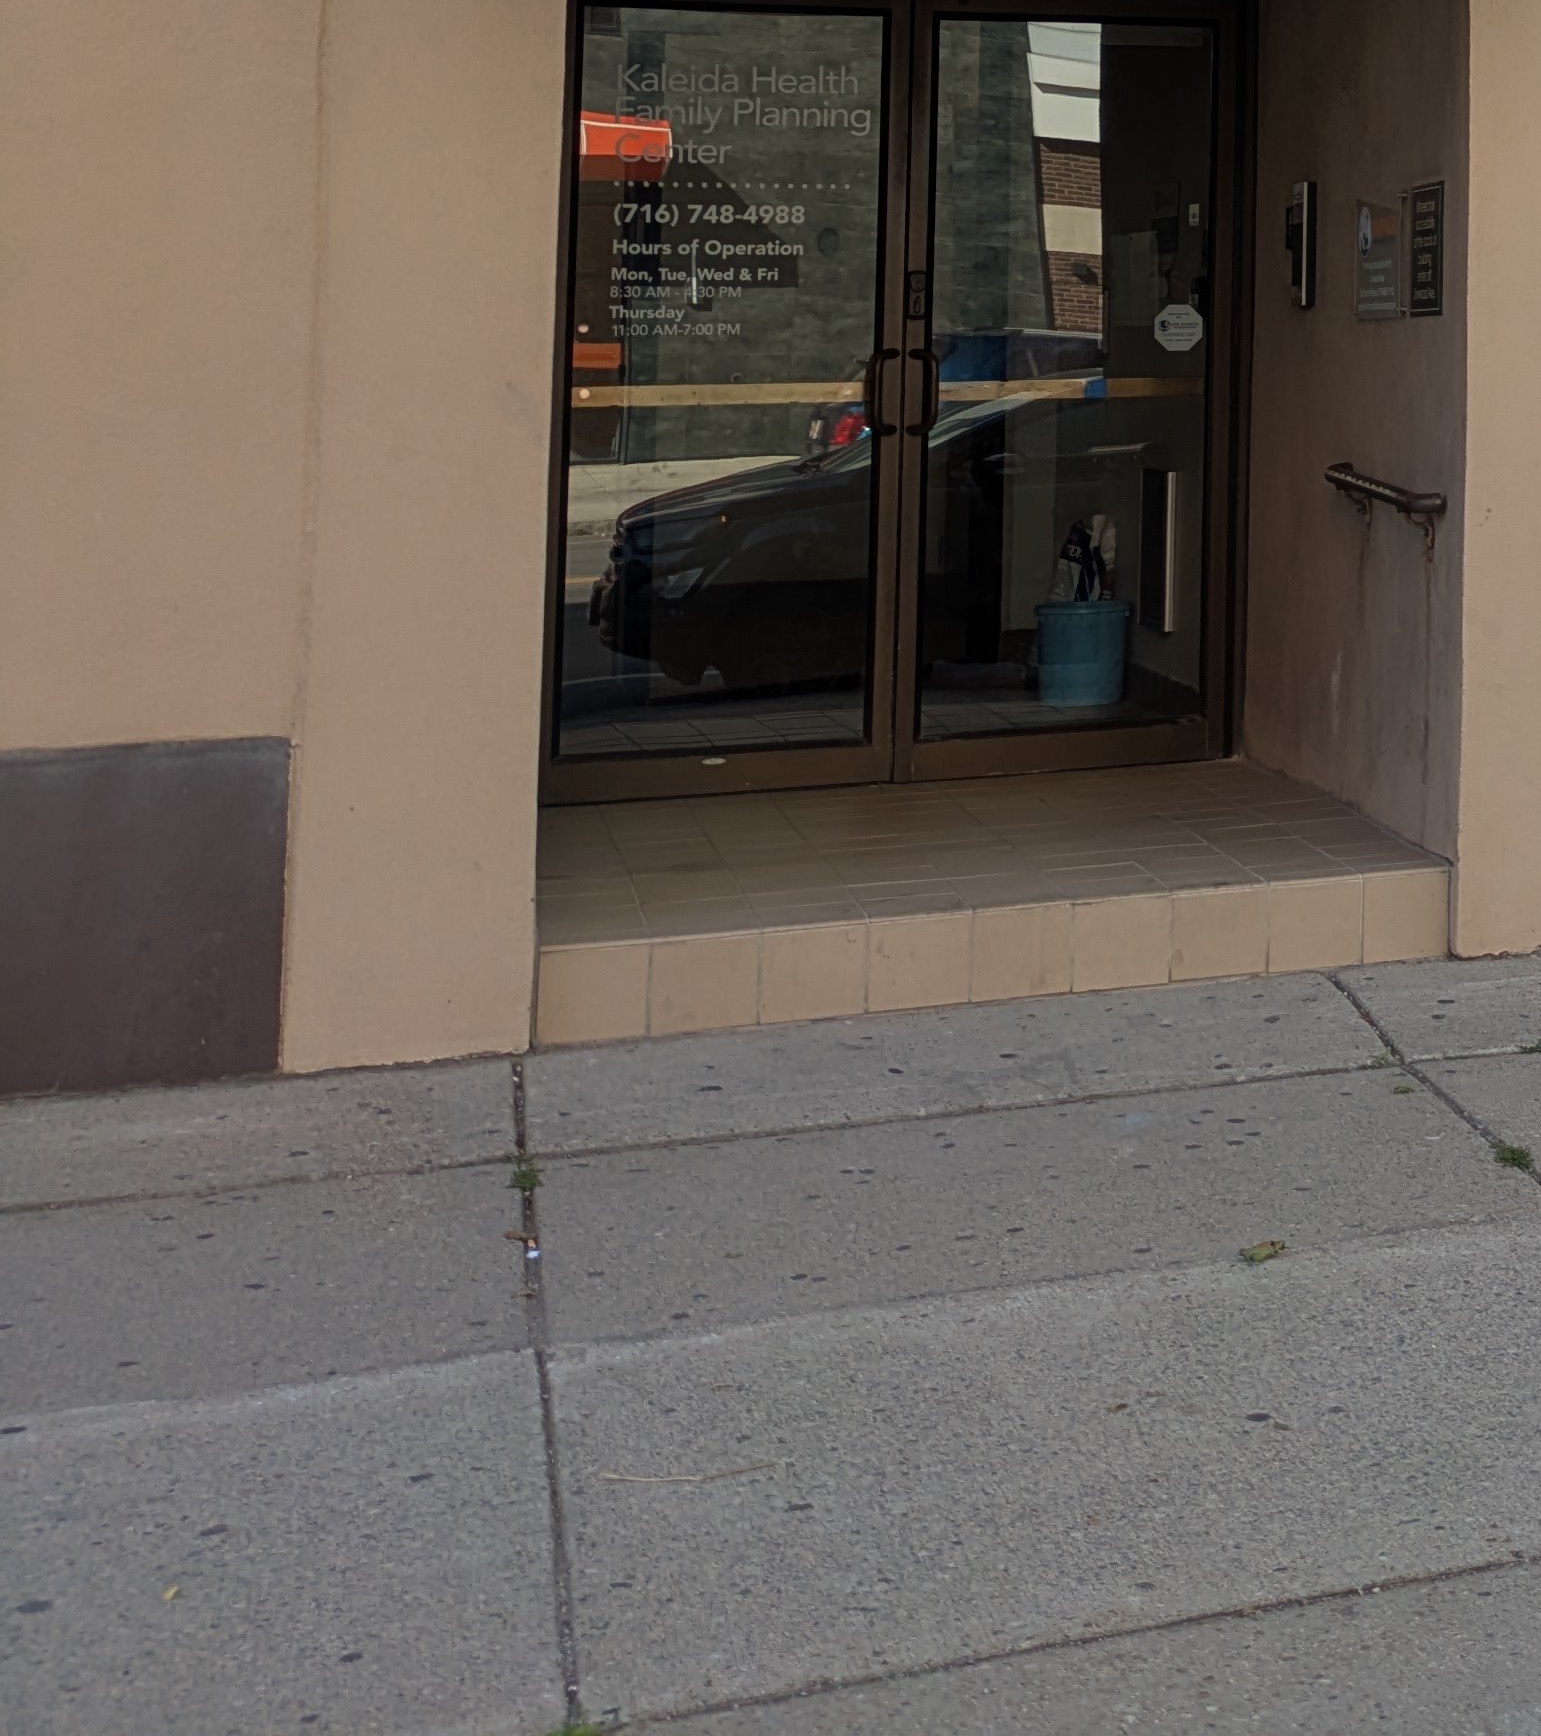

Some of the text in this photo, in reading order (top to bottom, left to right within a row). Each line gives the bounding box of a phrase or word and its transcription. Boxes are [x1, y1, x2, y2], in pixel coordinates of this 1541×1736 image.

[617, 64, 858, 94] Kaleida Health
[615, 96, 871, 136] Family Planning
[615, 133, 732, 164] Center
[613, 203, 805, 227] (716) 748-4988
[612, 238, 804, 259] Hours of Operation
[611, 267, 778, 283] Mon, Tue, Wed & Fri
[610, 286, 641, 298] 8:30
[644, 286, 671, 298] AM
[685, 286, 714, 298] 430
[719, 286, 742, 298] PM
[609, 305, 686, 322] Thursday
[611, 324, 741, 336] 11:00 AM-7:00 PM
